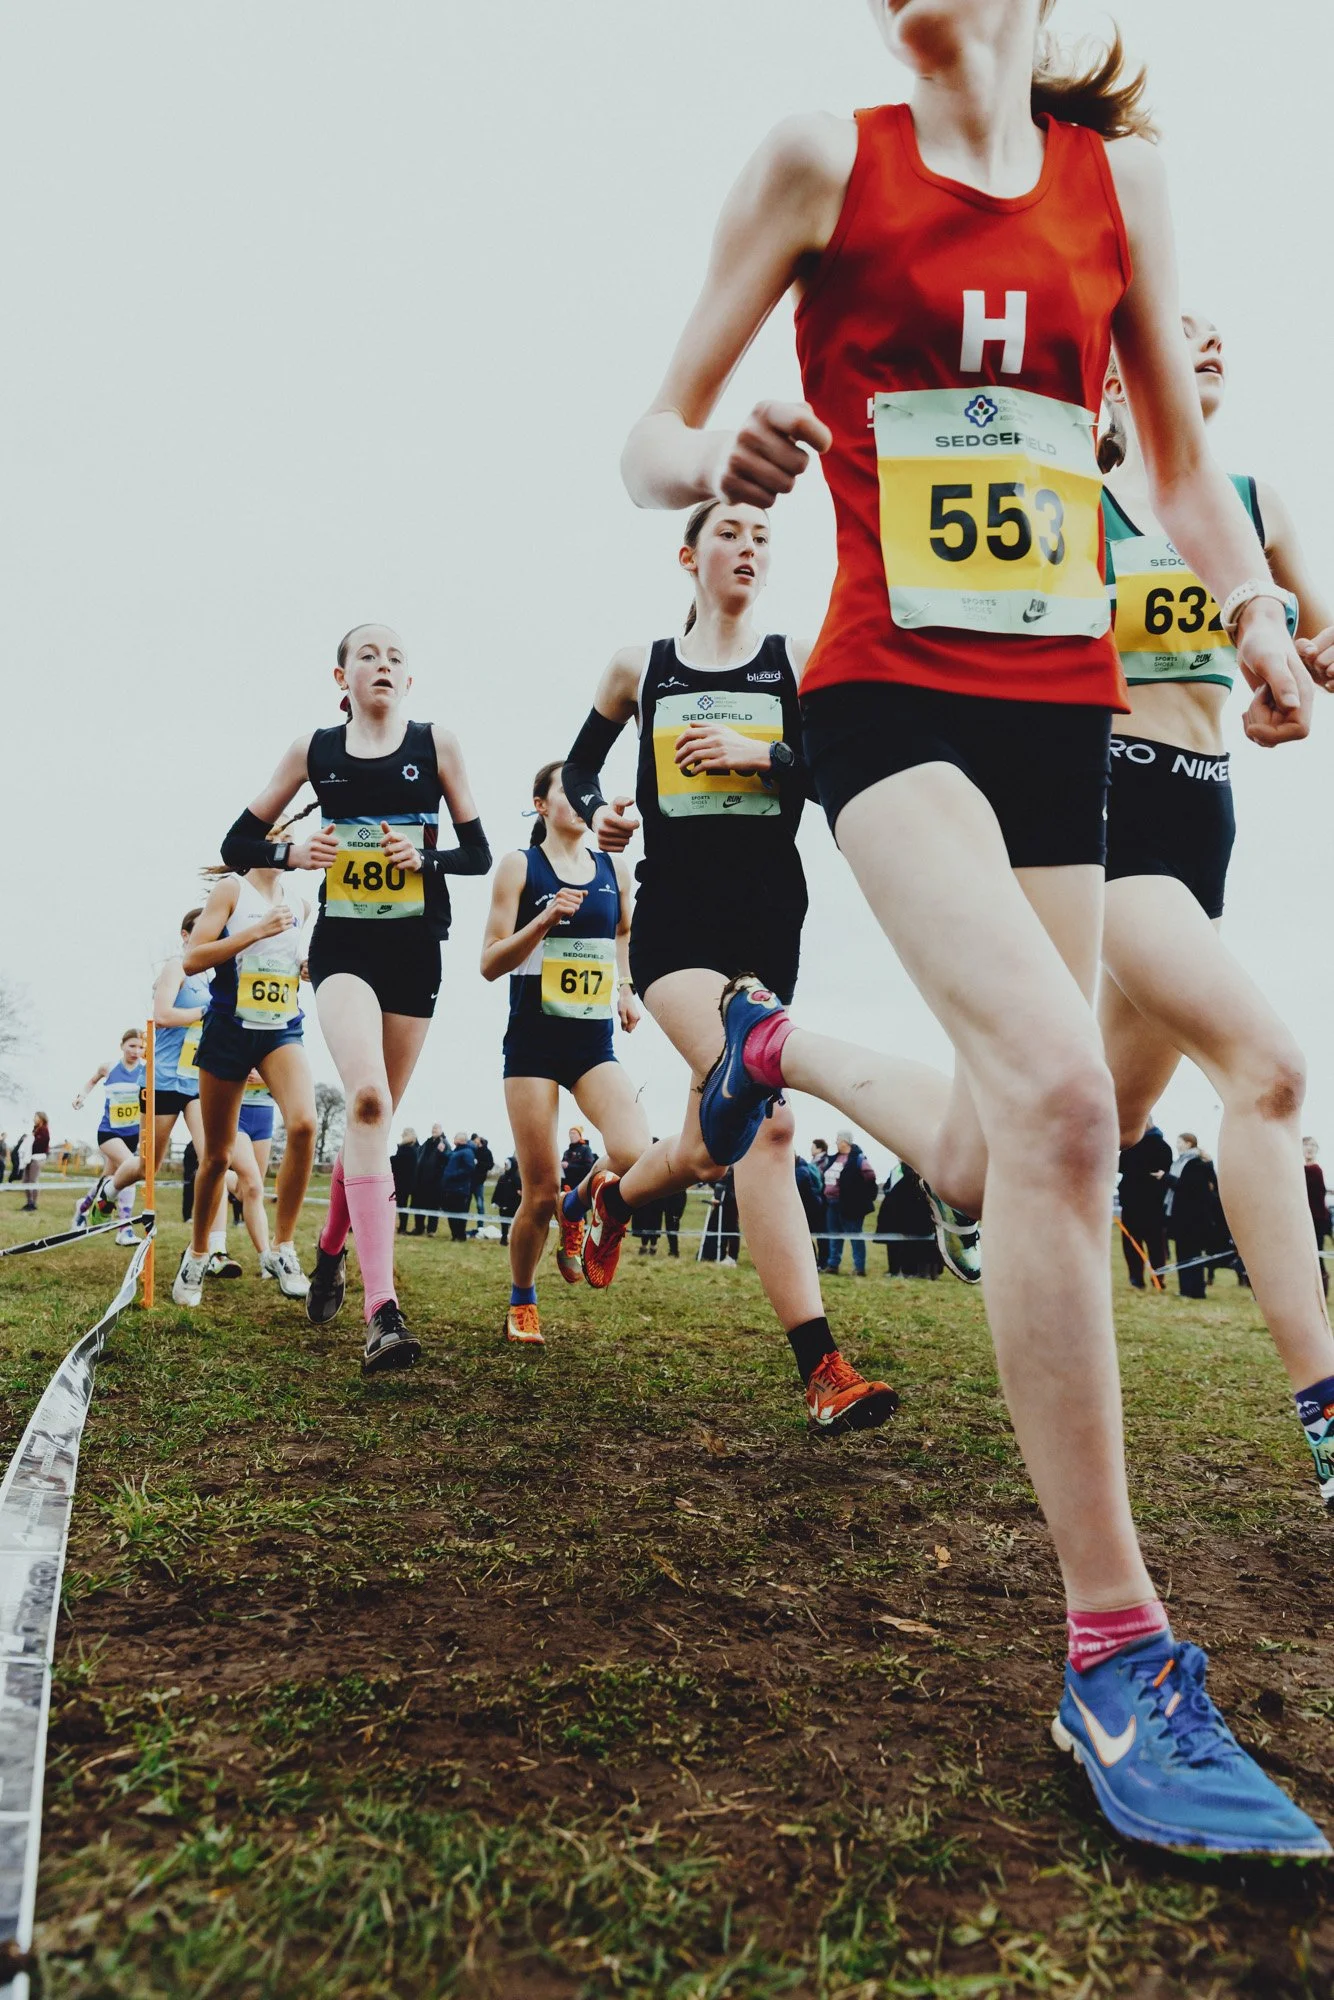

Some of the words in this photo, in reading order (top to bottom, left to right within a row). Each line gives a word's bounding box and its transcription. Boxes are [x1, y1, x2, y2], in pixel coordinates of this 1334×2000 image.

[959, 289, 1027, 374] H
[935, 432, 1057, 456] SEDGEFIELD
[929, 482, 1065, 566] 553
[1194, 653, 1211, 663] RUN
[682, 712, 753, 721] SEDGEFIELD
[1109, 739, 1156, 764] RO
[1171, 754, 1229, 782] NIKE
[343, 860, 406, 891] 480
[560, 968, 603, 995] 617
[117, 1106, 139, 1118] 607
